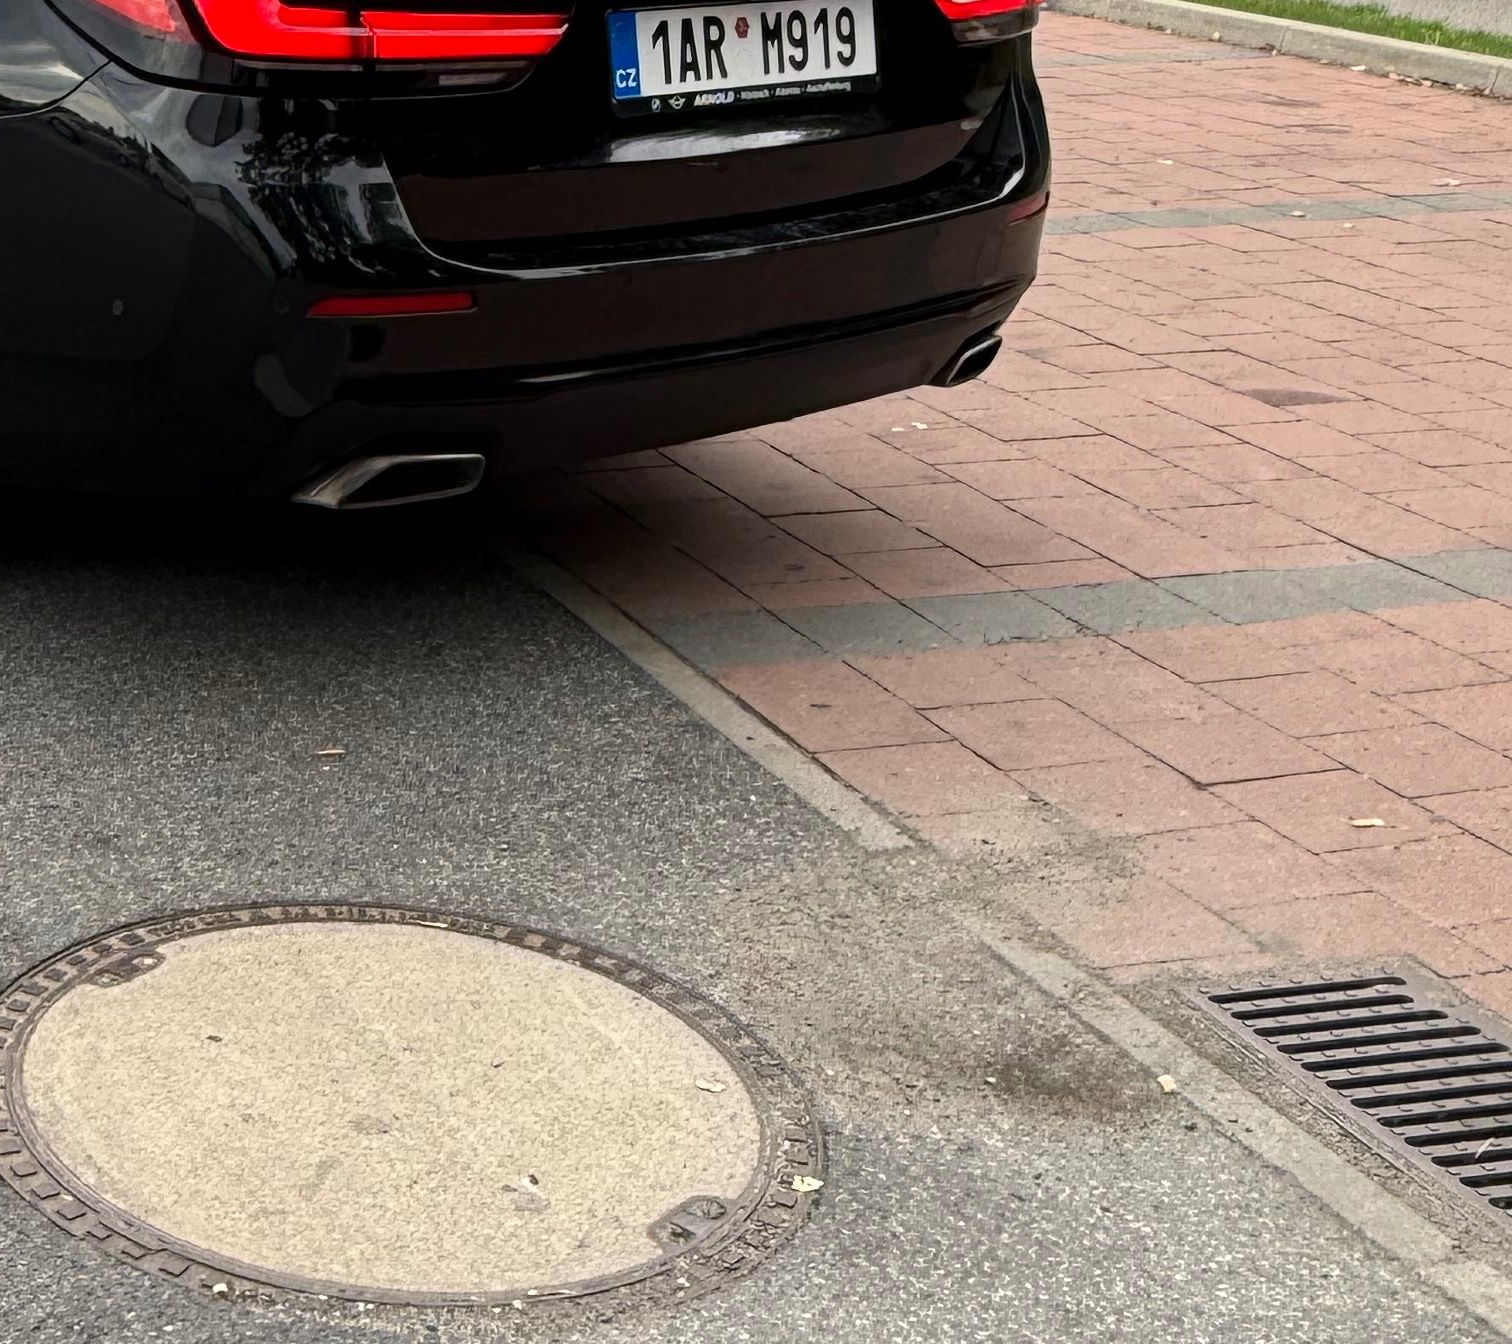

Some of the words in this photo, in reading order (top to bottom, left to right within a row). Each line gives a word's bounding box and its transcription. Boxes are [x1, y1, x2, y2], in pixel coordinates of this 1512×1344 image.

[651, 15, 728, 85] 1AR
[760, 6, 857, 76] M919
[615, 68, 638, 88] CZ
